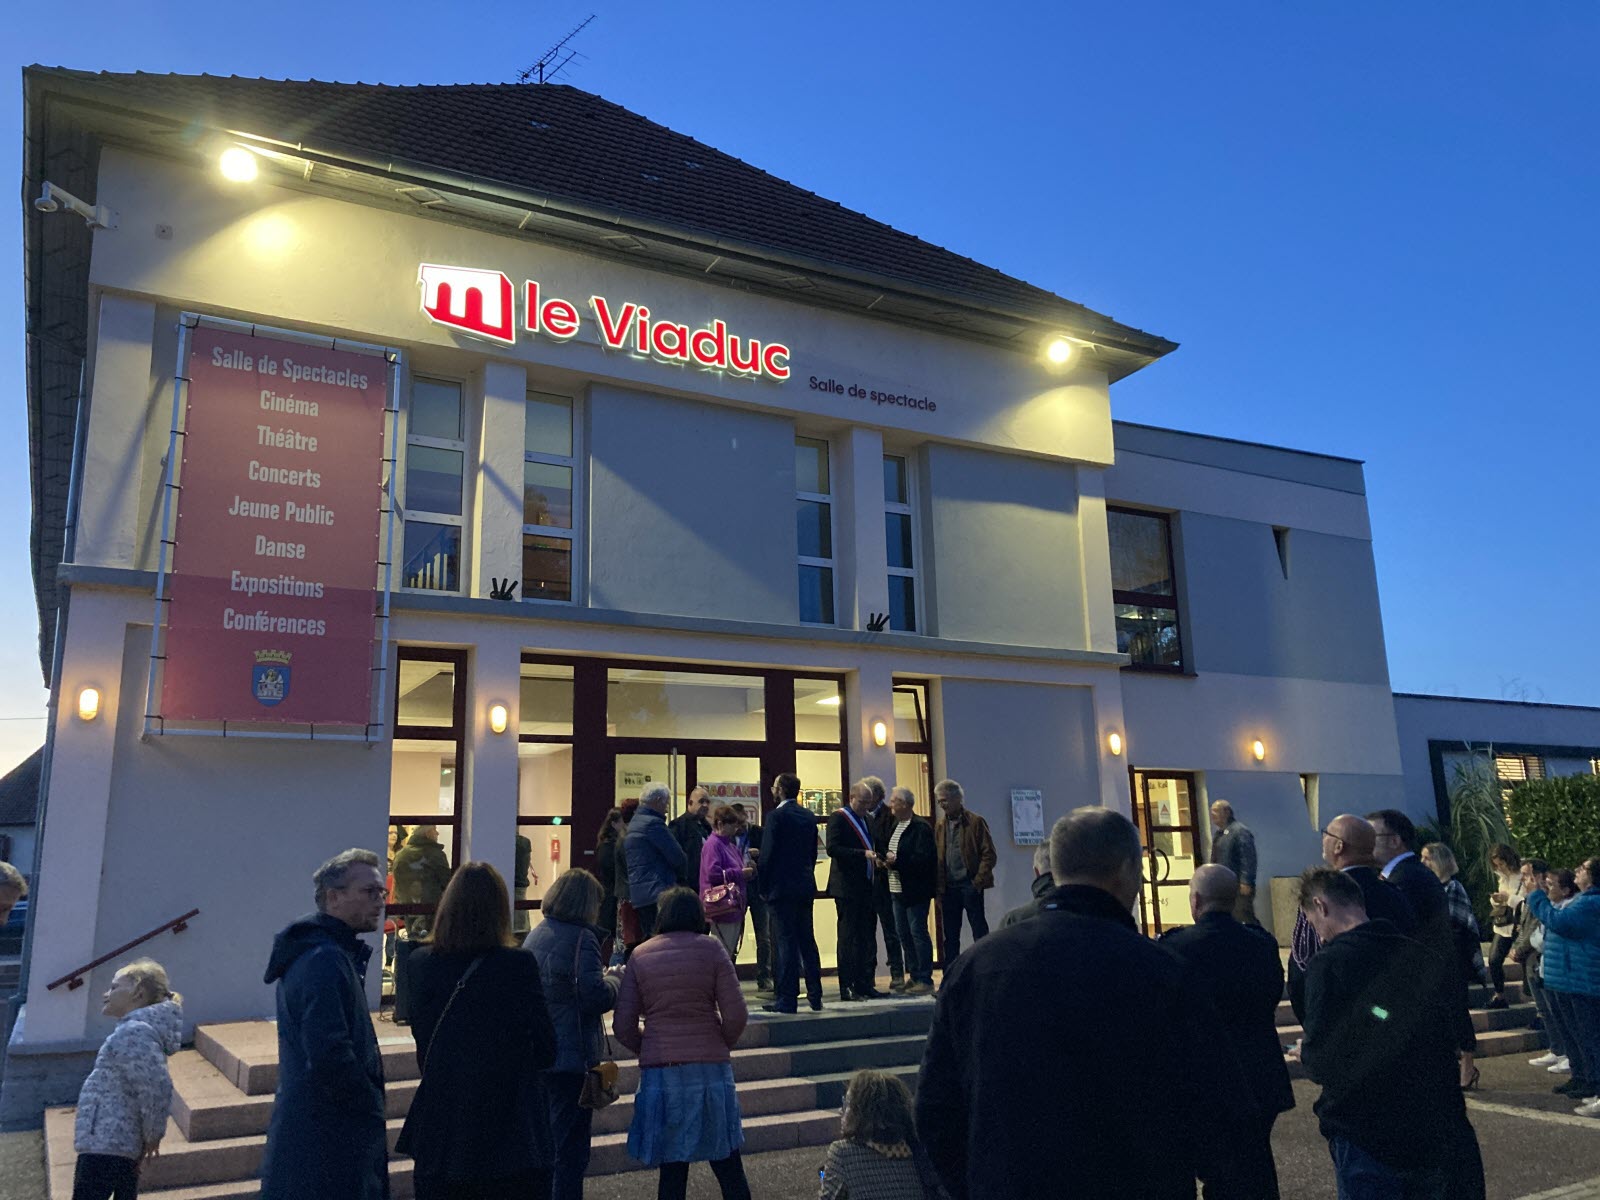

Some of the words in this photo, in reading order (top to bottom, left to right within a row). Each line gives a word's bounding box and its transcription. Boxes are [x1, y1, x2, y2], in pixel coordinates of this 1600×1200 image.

[523, 279, 580, 339] le
[588, 295, 792, 383] Viaduc
[211, 346, 253, 372] Salle
[258, 354, 277, 376] de
[282, 358, 368, 390] Spectacles
[260, 389, 319, 417] Cinéma
[809, 375, 845, 395] Salle
[848, 384, 867, 399] de
[870, 390, 937, 412] spectacle
[257, 424, 318, 452] Théâtre
[248, 460, 321, 488] Concerts
[228, 495, 280, 520] Jeune
[285, 501, 335, 526] Public
[255, 535, 306, 560] Danse
[230, 570, 324, 598] Expositions
[223, 607, 326, 636] Conférences
